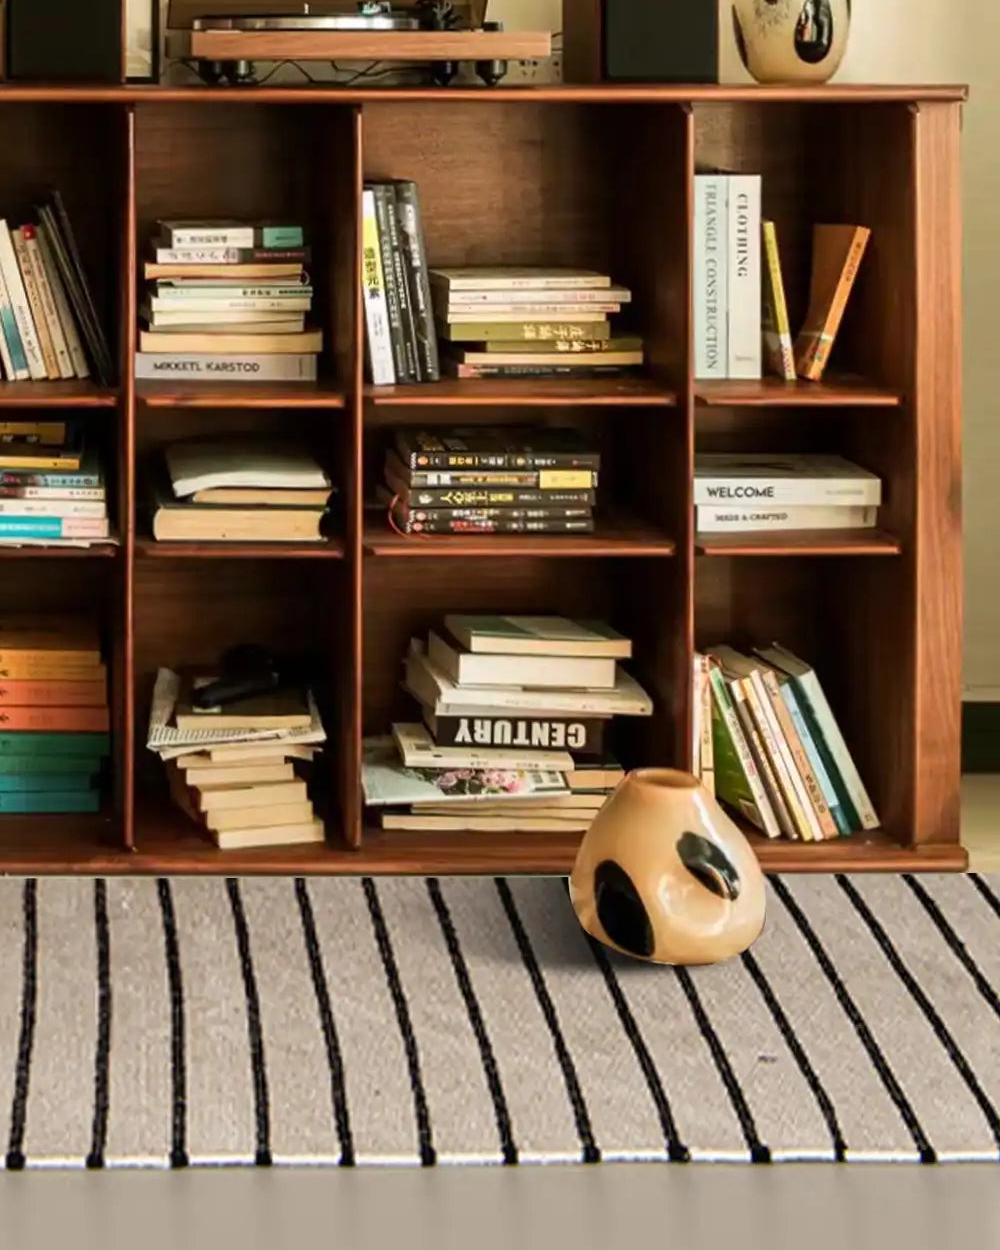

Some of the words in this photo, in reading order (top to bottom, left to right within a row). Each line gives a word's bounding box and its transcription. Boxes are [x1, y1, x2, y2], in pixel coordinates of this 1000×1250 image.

[736, 193, 749, 278] CLOTHING
[705, 258, 719, 370] CONSTRUCTION
[706, 486, 775, 498] WELCOME
[454, 718, 587, 748] CENTURY
